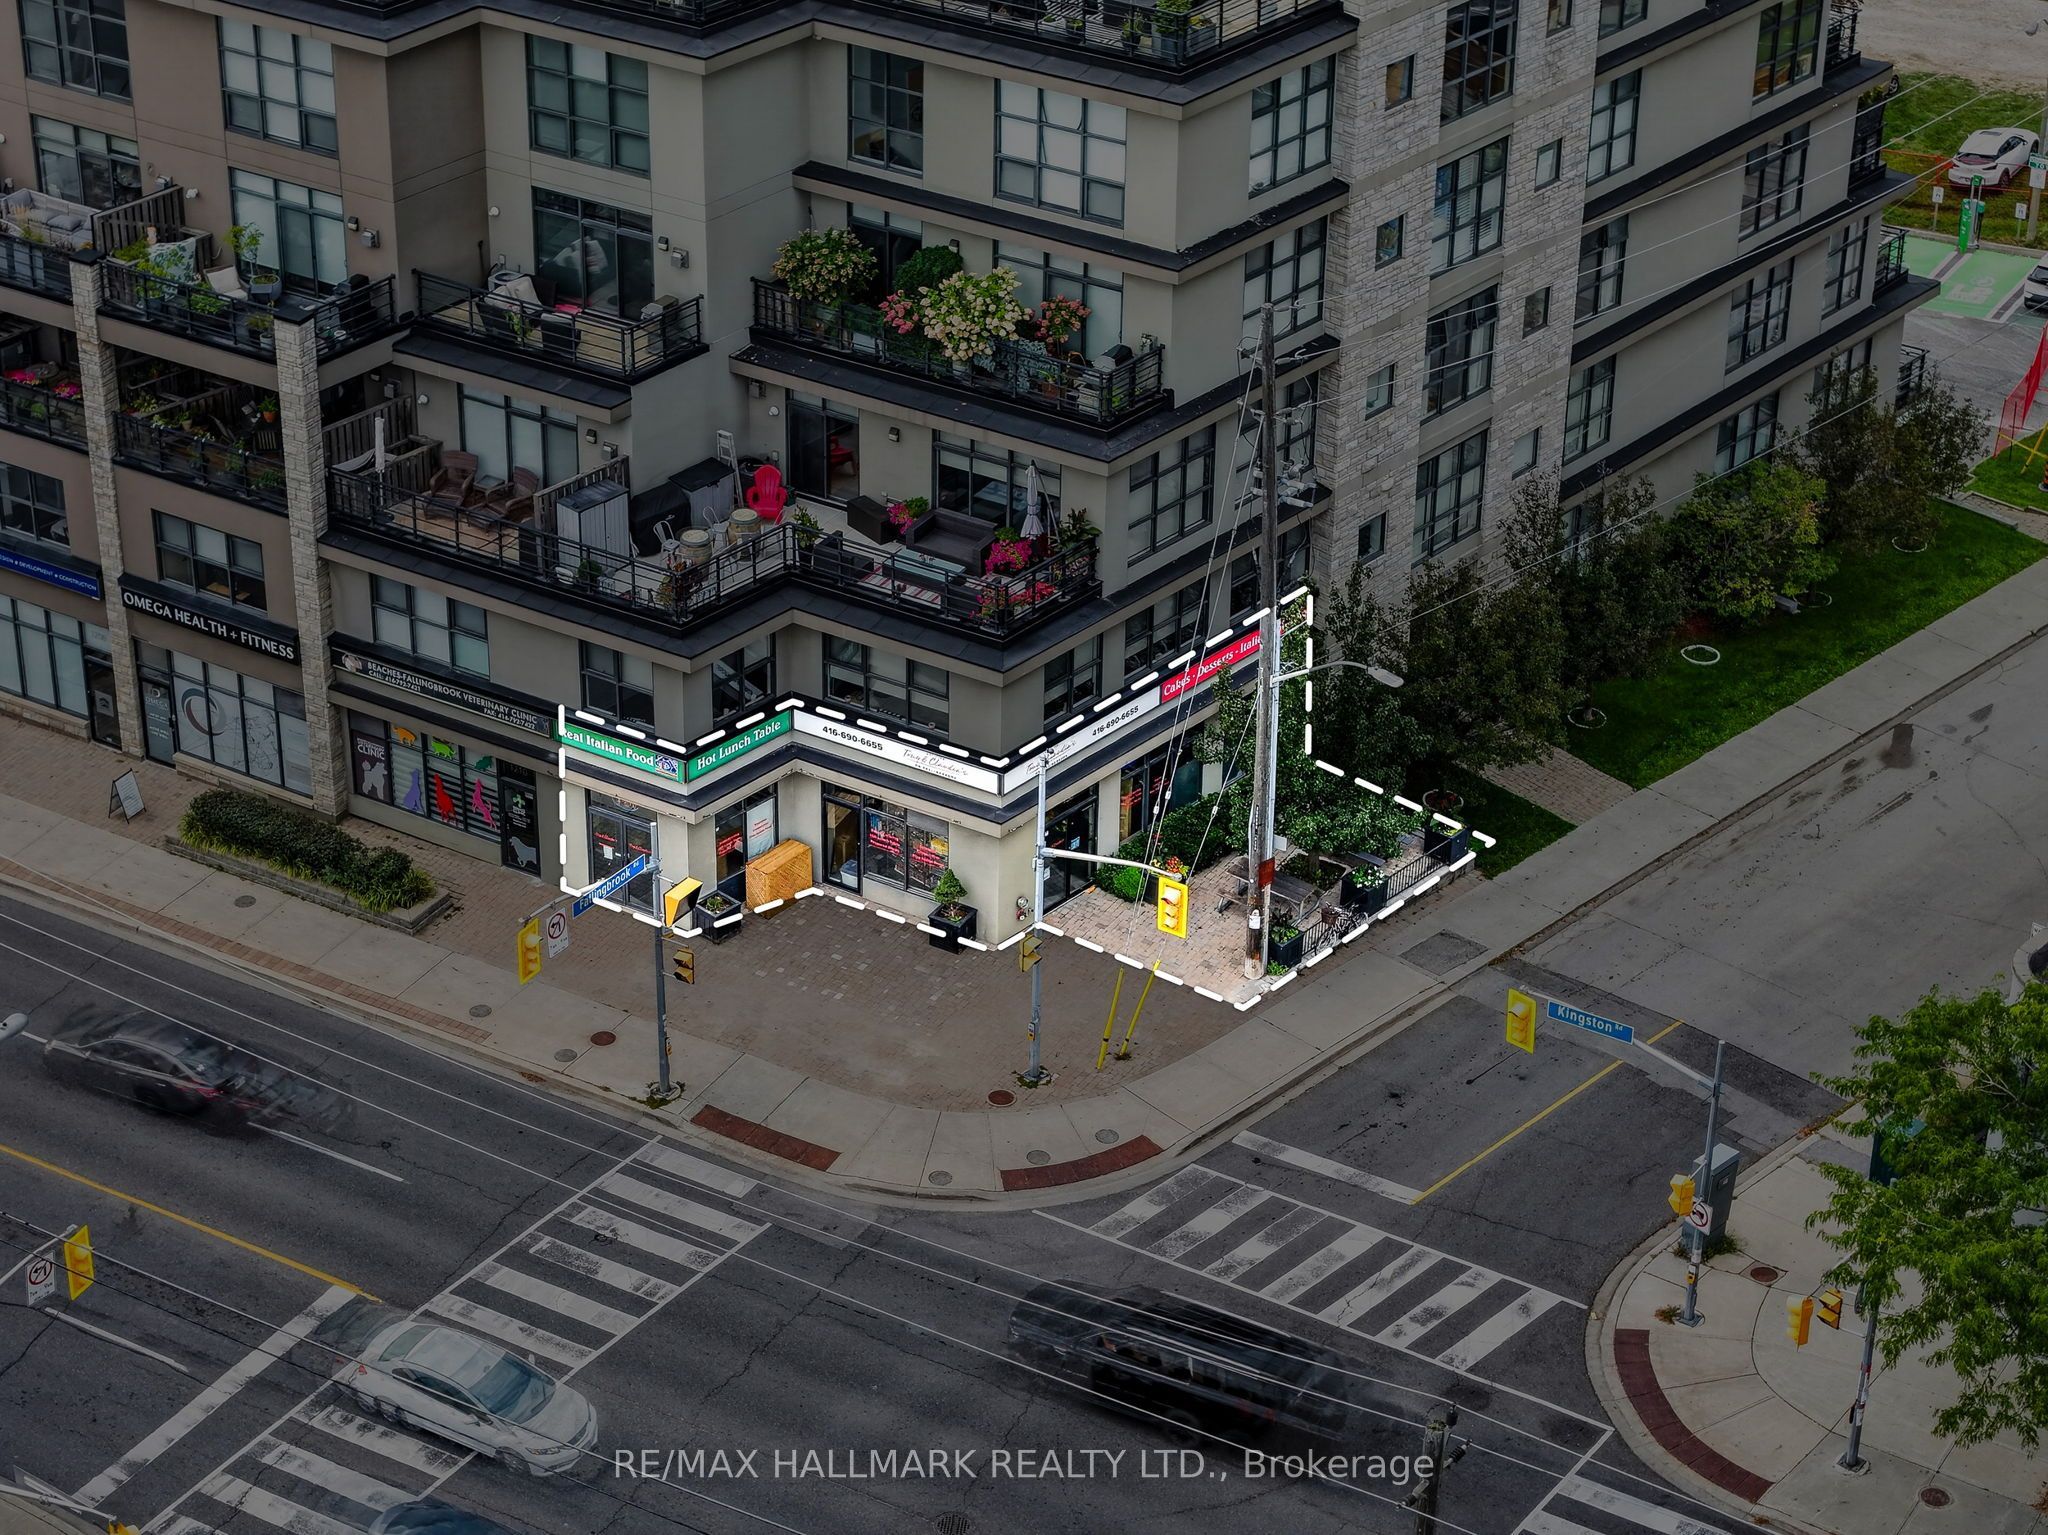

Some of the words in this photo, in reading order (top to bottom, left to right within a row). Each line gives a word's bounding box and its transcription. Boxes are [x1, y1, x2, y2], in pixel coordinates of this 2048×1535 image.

[59, 574, 97, 591] CONSTRUCTION
[123, 592, 173, 619] OMEGA
[174, 608, 227, 637] HEALTH
[230, 631, 238, 640] +
[240, 632, 295, 660] FITNESS
[1163, 675, 1191, 695] Cakes
[1196, 651, 1234, 677] Desserts
[367, 661, 462, 699] BEACHES-FALLINGBROOK
[463, 691, 509, 715] VETERINARY
[511, 708, 538, 724] CLINIC
[1092, 705, 1139, 736] 416-690-6655
[357, 744, 385, 760] CLINIC
[586, 734, 623, 756] Italian
[626, 747, 655, 767] Food
[697, 754, 716, 770] Hot
[719, 735, 751, 758] Lunch
[753, 721, 781, 740] Table
[822, 725, 883, 751] 416-690-6655
[579, 868, 631, 910] Fallingbrook
[1557, 1005, 1613, 1033] Kingston
